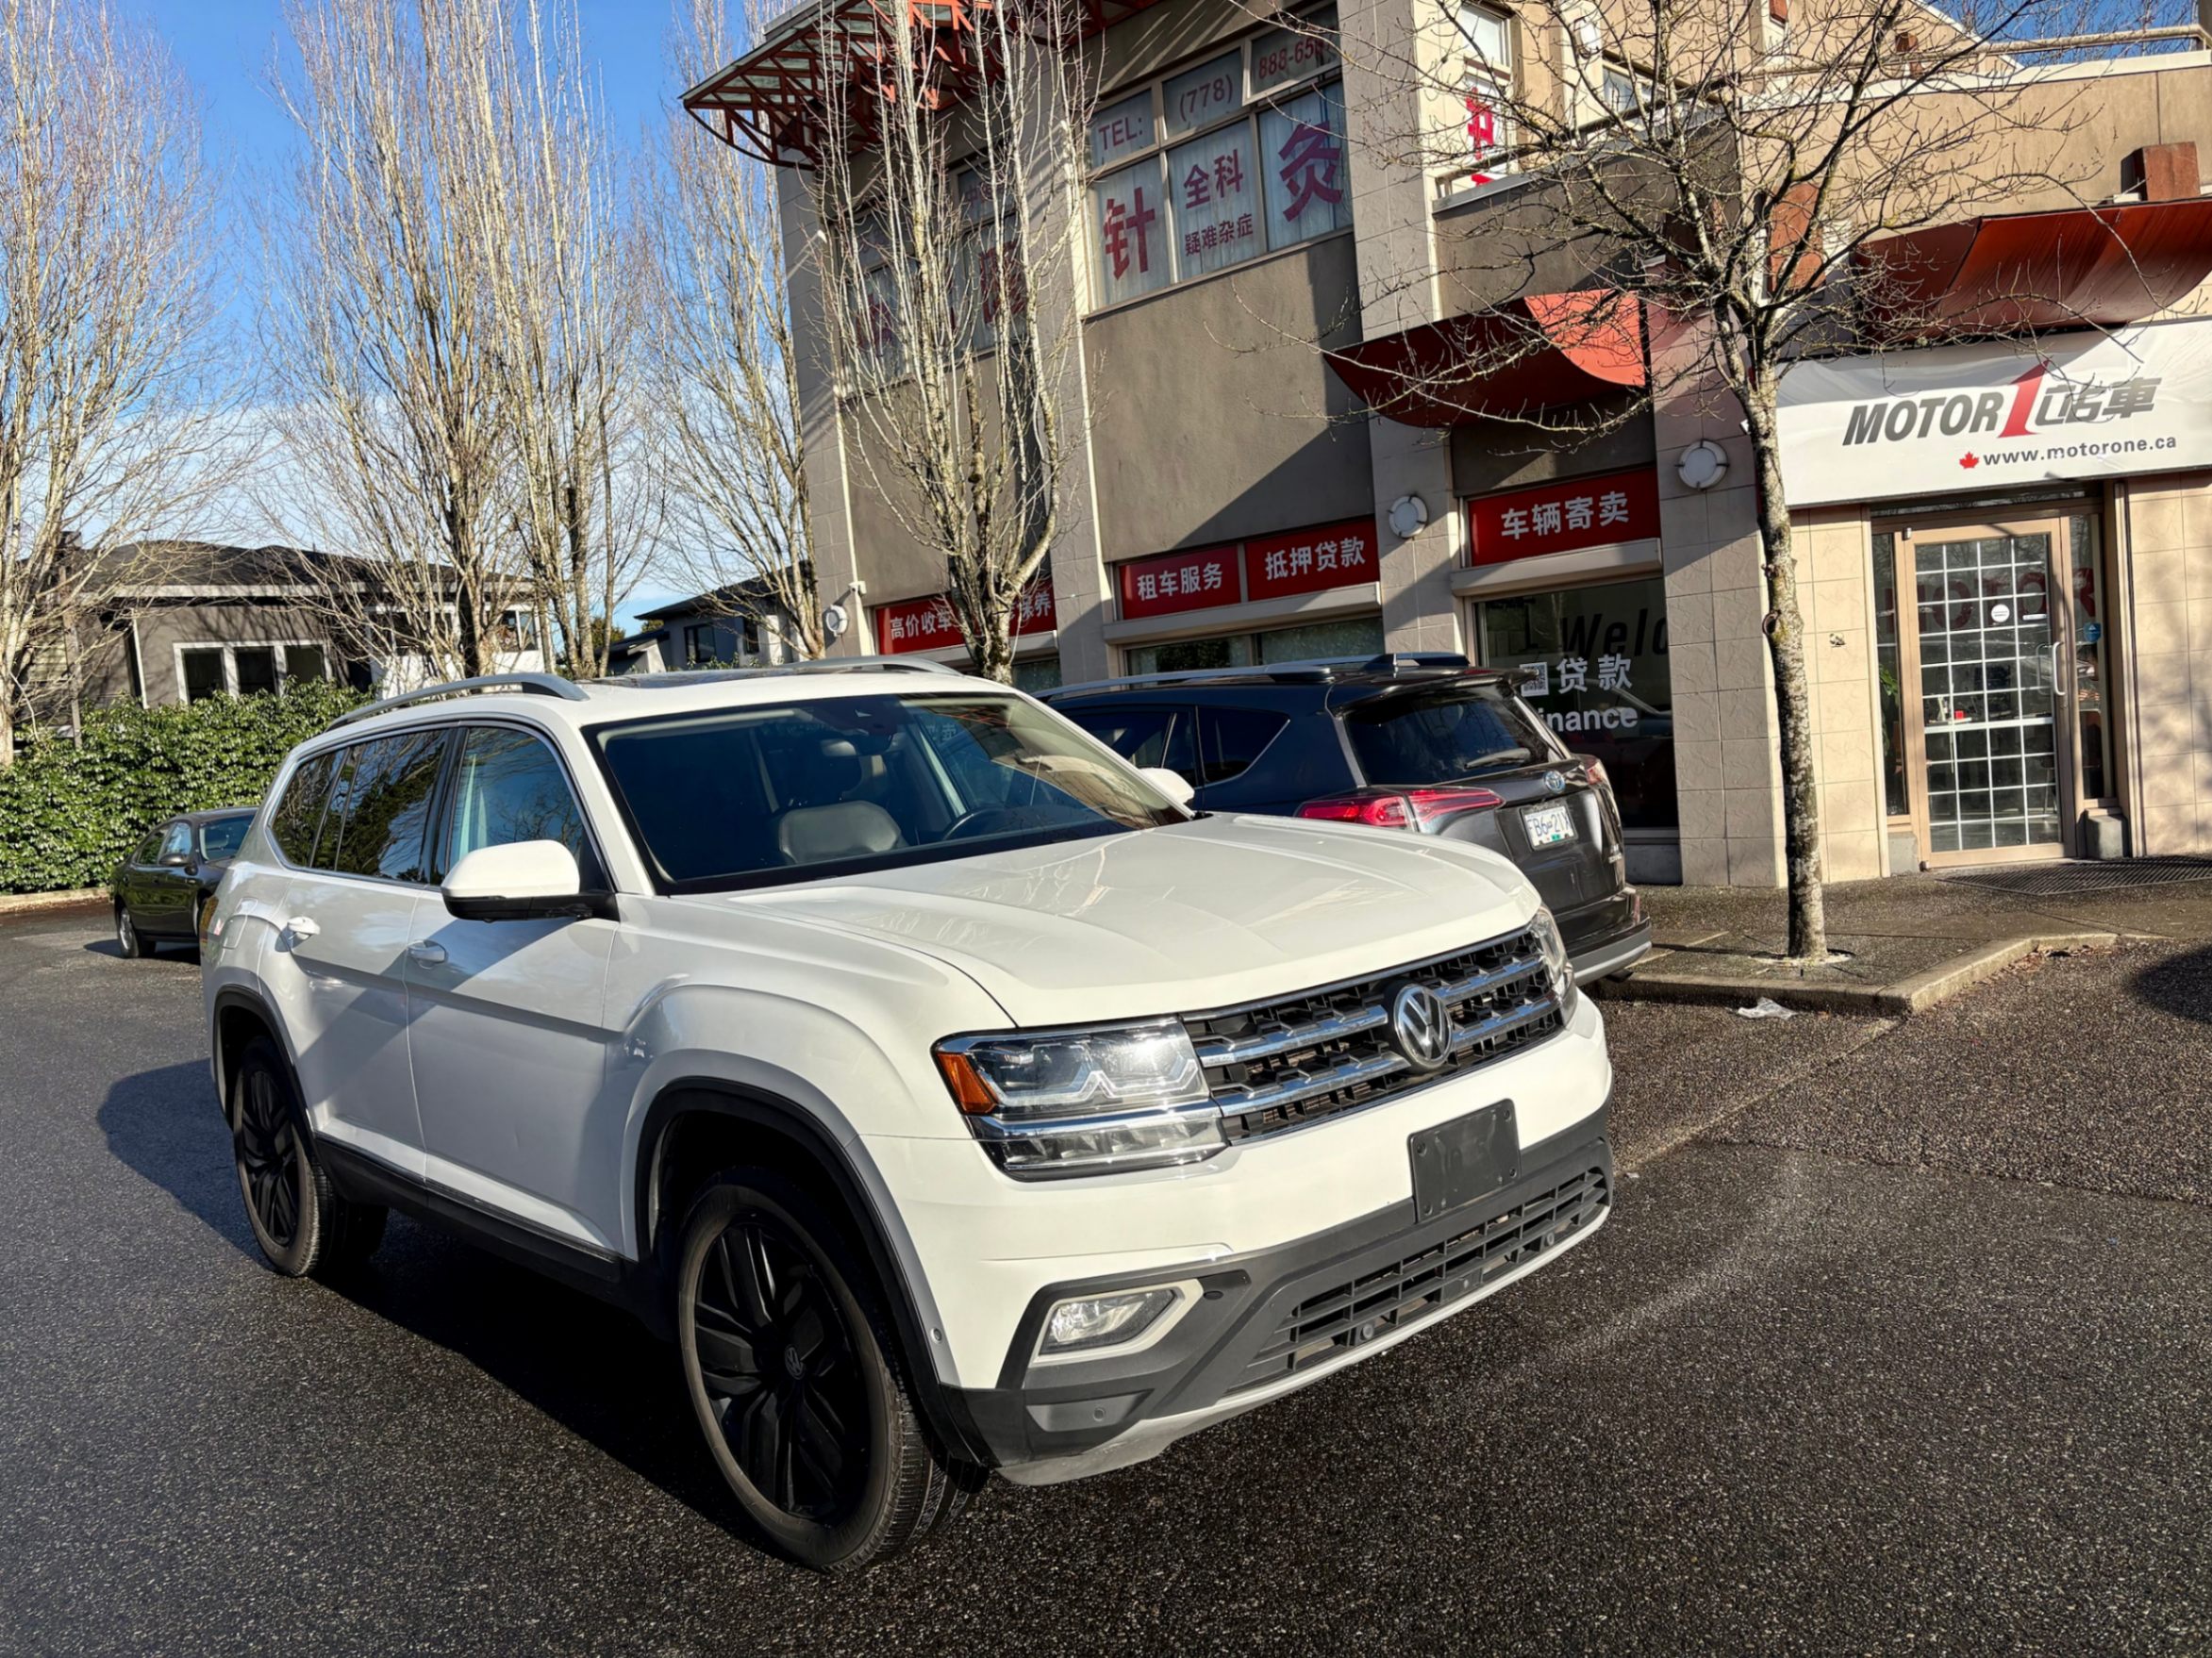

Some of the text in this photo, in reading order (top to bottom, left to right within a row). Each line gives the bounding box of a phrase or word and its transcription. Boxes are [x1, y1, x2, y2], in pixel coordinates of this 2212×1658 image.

[1098, 116, 1143, 151] TEL:
[1180, 75, 1234, 122] (778)
[1103, 187, 1156, 280] 针
[1278, 121, 1343, 222] 灸
[1184, 149, 1243, 208] 全科
[1185, 213, 1254, 257] 疑难杂症
[1983, 434, 2177, 466] www.motorone.ca
[1501, 490, 1629, 540] 车辆寄卖
[1265, 537, 1366, 581] 抵押贷款
[1138, 563, 1222, 601] 租车服务
[1556, 654, 1633, 695] 贷款
[1538, 706, 1638, 733] inance
